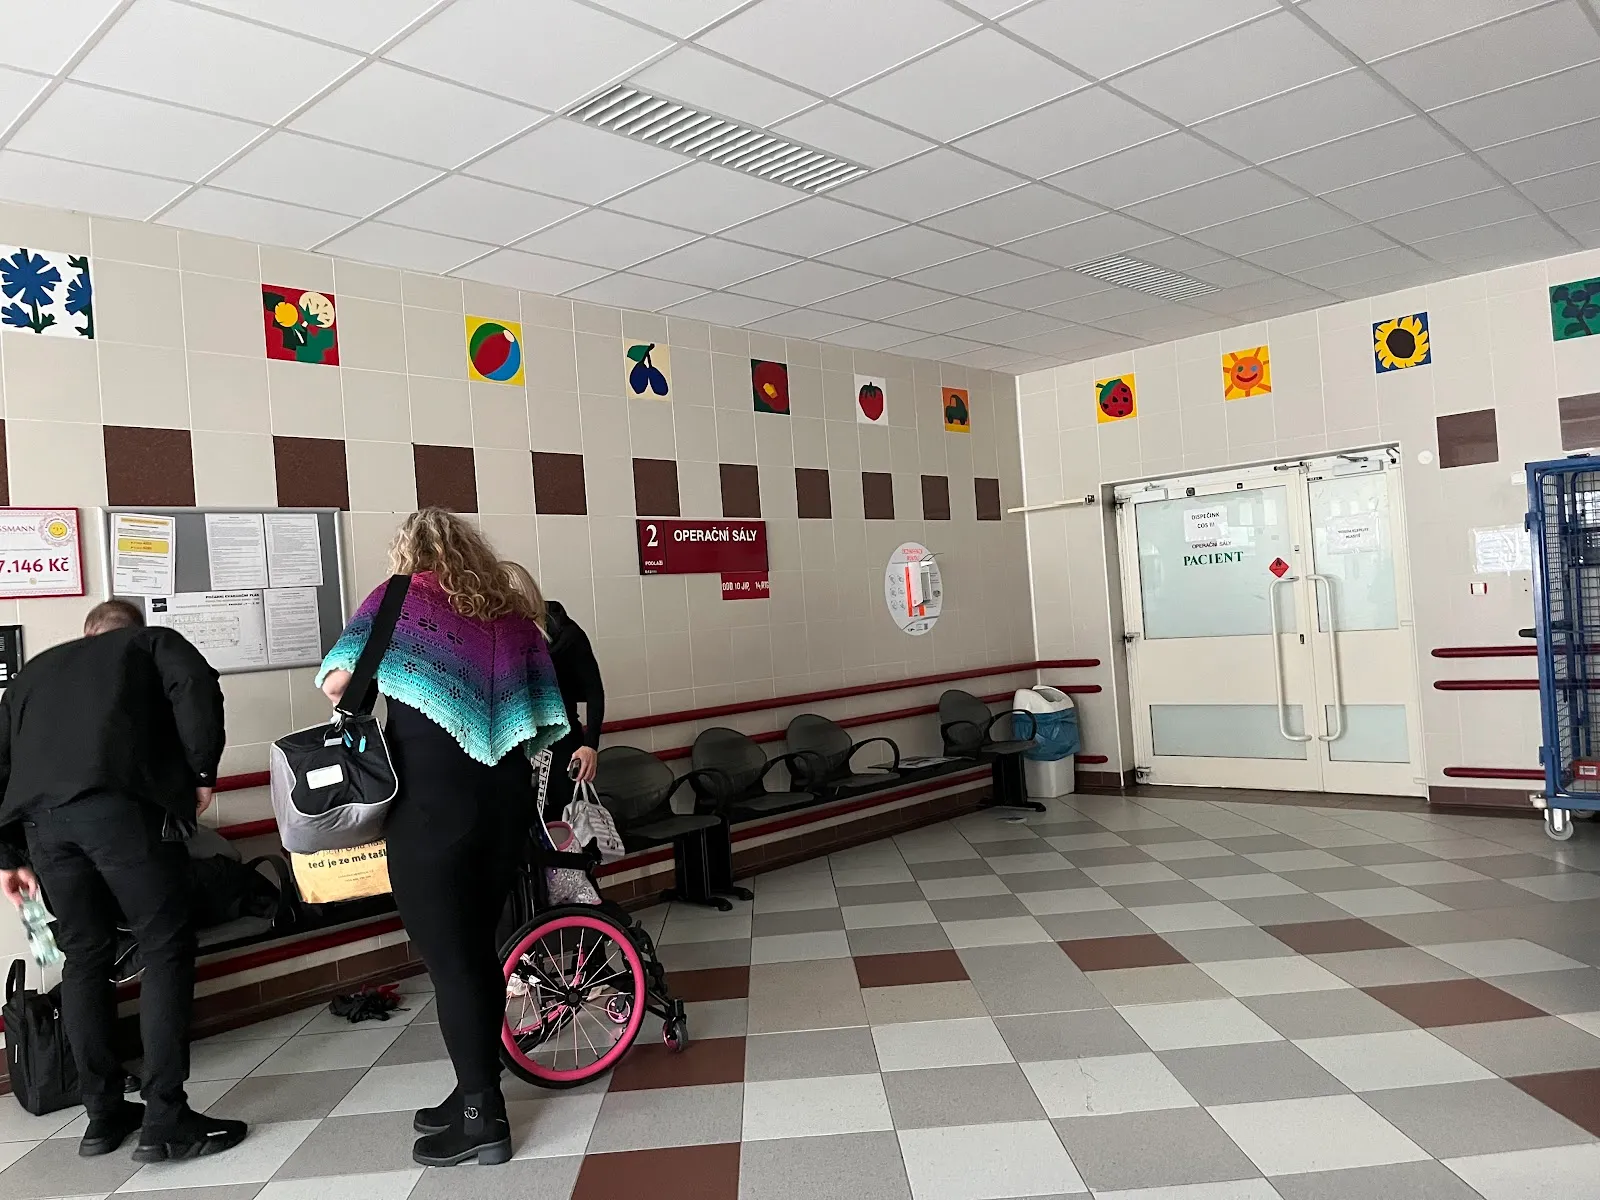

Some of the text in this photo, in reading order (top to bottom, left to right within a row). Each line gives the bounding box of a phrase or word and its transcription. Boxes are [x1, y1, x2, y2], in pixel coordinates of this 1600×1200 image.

[646, 524, 659, 547] 2
[673, 526, 757, 542] OPERAČNÍ SÁLY
[49, 557, 70, 572] Kč
[1183, 551, 1244, 566] PACIENT
[327, 858, 337, 869] je
[351, 853, 367, 863] mě
